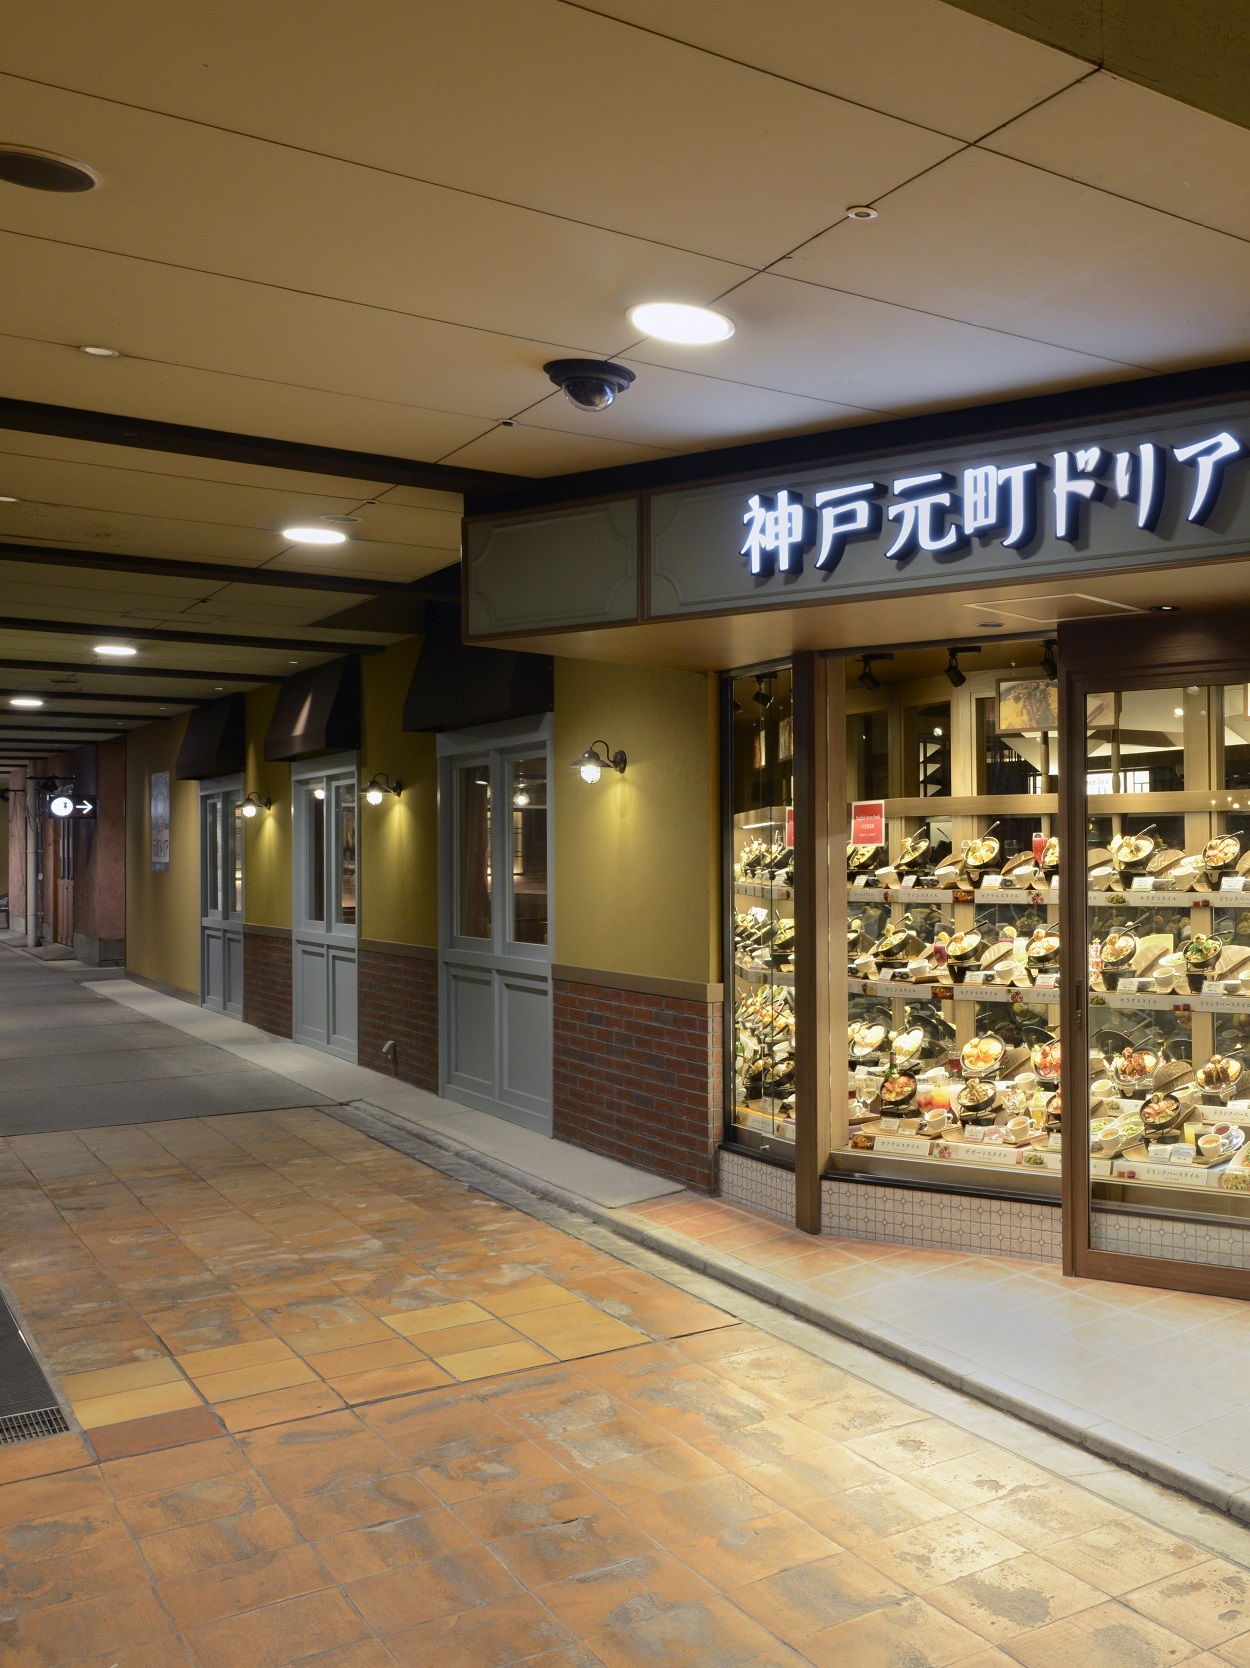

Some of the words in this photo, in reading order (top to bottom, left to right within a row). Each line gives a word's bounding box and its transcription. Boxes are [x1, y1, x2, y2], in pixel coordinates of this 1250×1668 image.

[740, 431, 1243, 576] 神戸元町ドリア
[880, 1140, 921, 1150] カクテルスタイル
[965, 1148, 1008, 1158] デザートスタイル
[1146, 1168, 1200, 1179] ドリンクバースタイル
